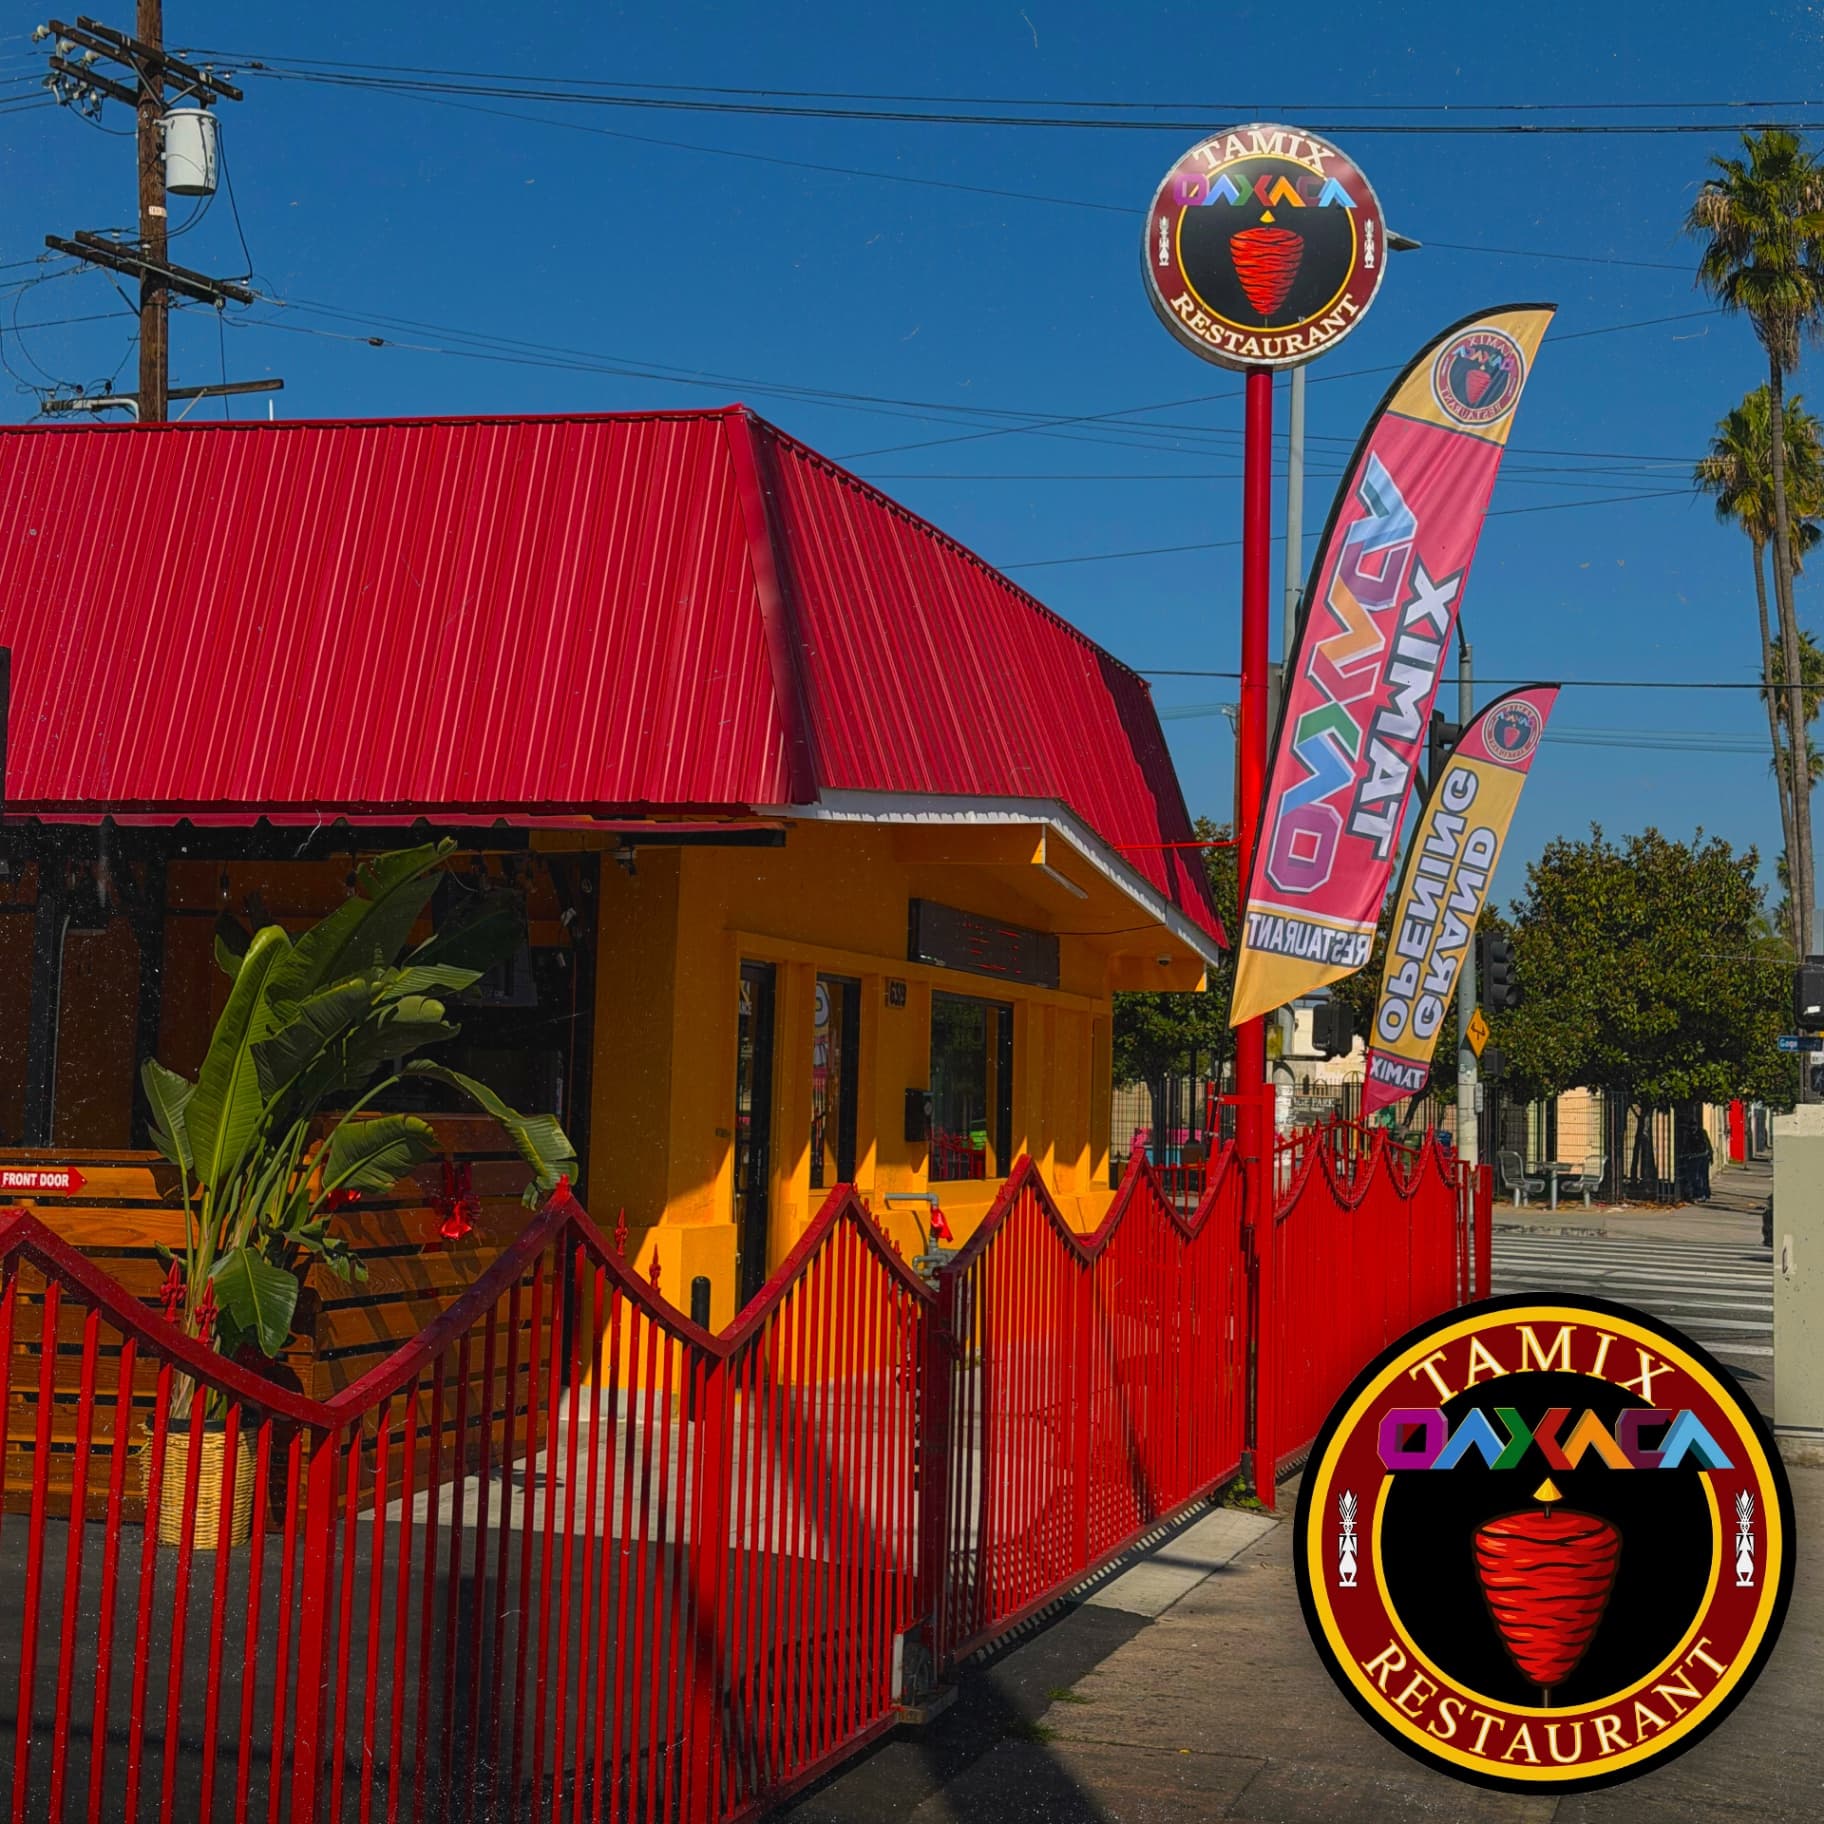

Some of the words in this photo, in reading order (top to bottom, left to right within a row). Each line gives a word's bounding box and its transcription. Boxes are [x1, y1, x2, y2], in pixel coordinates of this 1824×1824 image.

[1193, 130, 1335, 173] TAMIX
[1174, 174, 1357, 208] OAXACA
[1171, 292, 1361, 357] RESTAURANT
[2, 1172, 37, 1187] FRONT
[40, 1173, 69, 1187] DOOR
